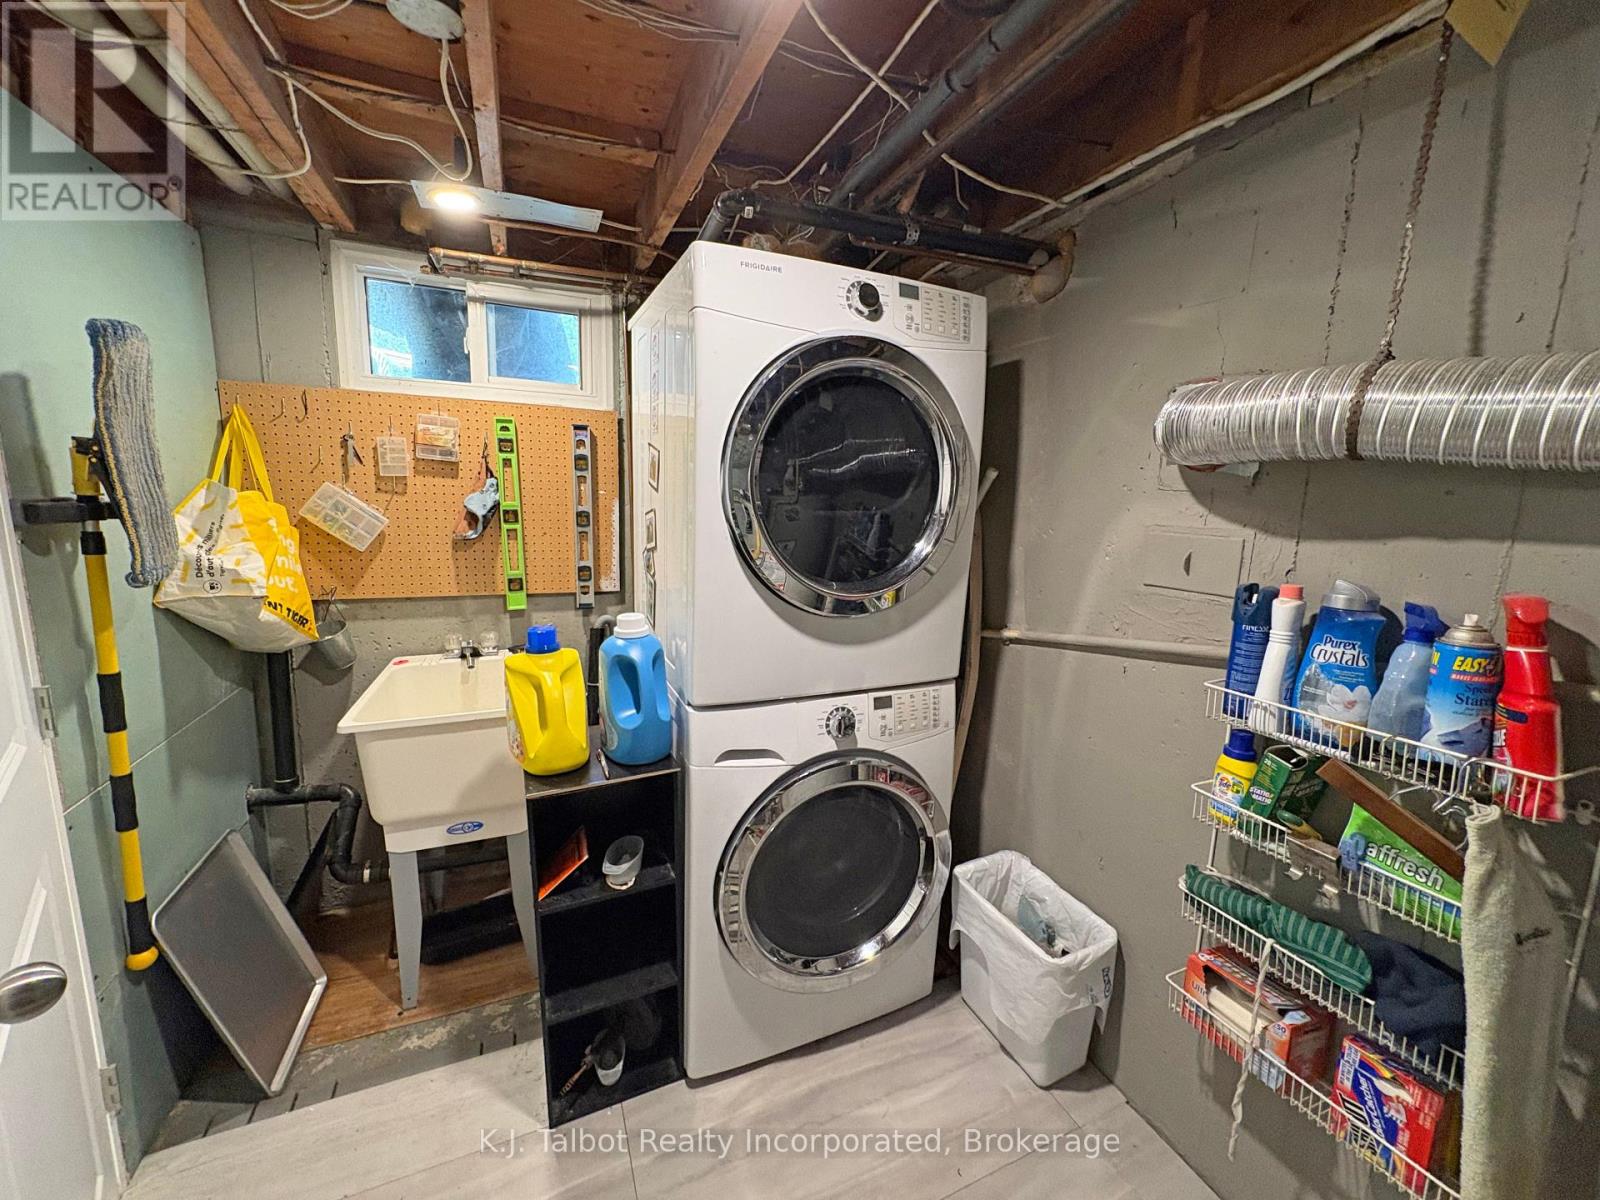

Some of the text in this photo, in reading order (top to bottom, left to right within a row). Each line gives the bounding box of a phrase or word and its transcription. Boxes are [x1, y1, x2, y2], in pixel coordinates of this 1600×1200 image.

[740, 260, 783, 274] FRIGIDAIRE
[1323, 634, 1360, 651] Purex
[1310, 643, 1369, 668] Crystals
[1366, 841, 1444, 891] affresh
